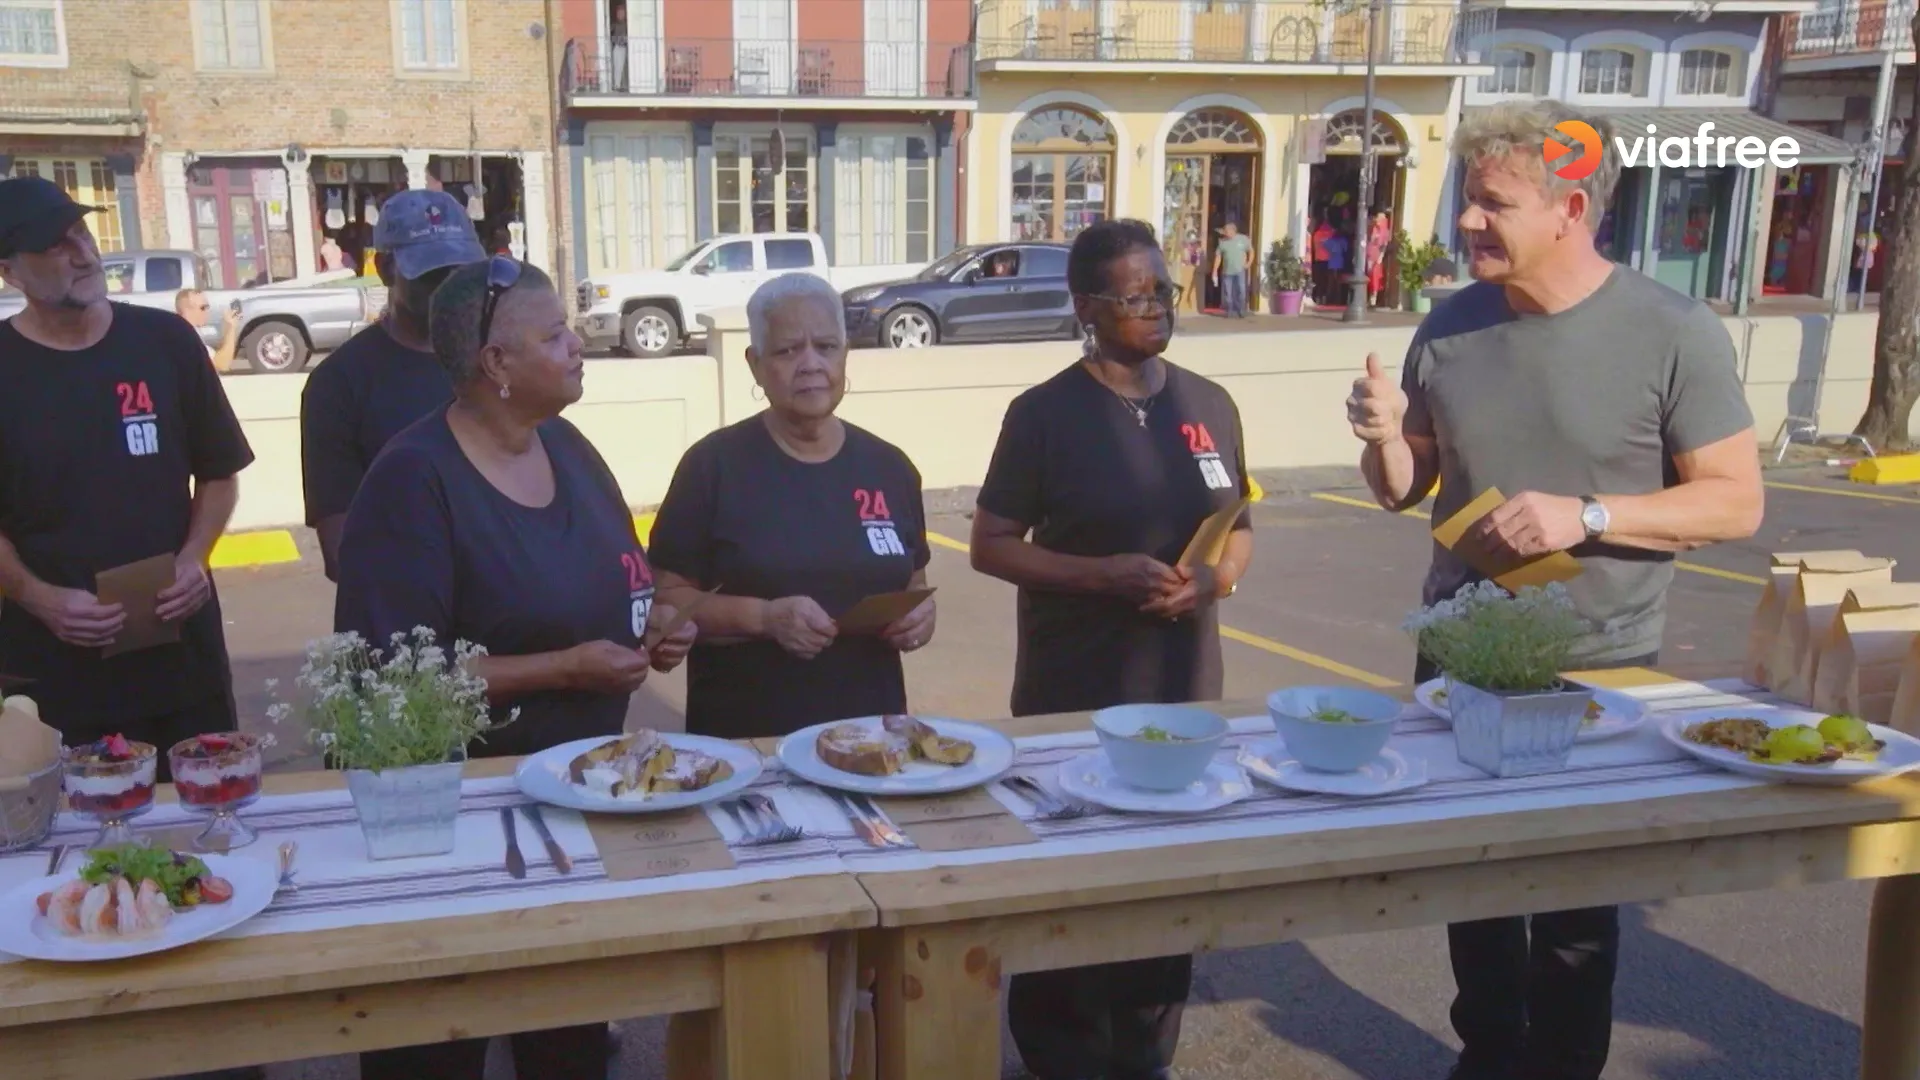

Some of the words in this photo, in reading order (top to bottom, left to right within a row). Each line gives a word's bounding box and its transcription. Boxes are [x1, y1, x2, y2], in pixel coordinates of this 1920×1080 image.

[116, 381, 153, 415] 24
[126, 422, 158, 455] GR
[1182, 423, 1215, 453] 24
[854, 488, 890, 520] 24
[866, 527, 905, 556] GR
[621, 550, 653, 590] 24
[632, 597, 653, 637] G
